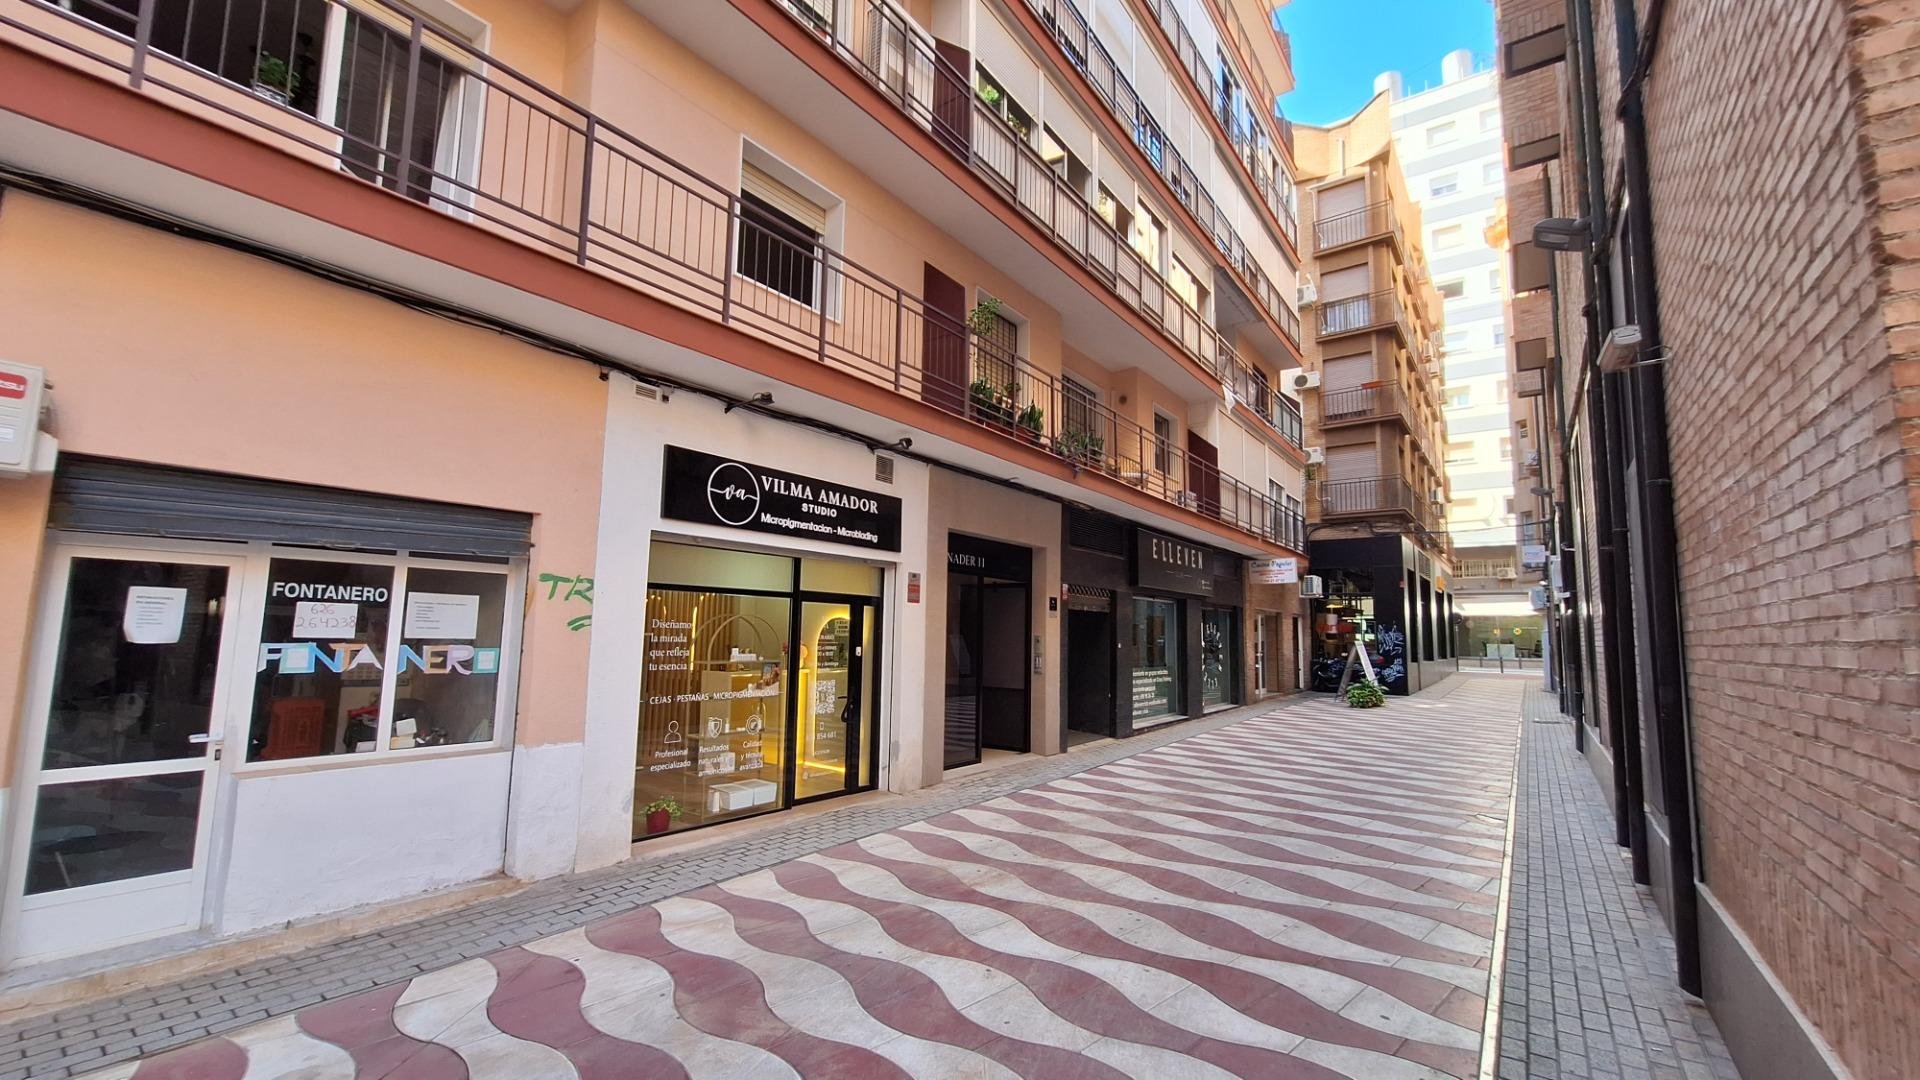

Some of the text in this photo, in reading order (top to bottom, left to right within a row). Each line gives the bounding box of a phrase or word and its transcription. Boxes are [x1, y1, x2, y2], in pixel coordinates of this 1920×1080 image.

[761, 475, 879, 514] VILMA AMADOR
[802, 503, 837, 518] STUDIO
[272, 582, 388, 602] FONTANERO
[311, 603, 335, 614] 626
[295, 615, 357, 628] 264238
[650, 632, 687, 642] la mirada
[649, 646, 689, 659] que refleja
[649, 662, 687, 671] tu esencia
[649, 695, 672, 705] CEJAS
[676, 692, 709, 703] PESTAÑAS
[655, 748, 688, 758] Profesional
[699, 744, 729, 753] Resultados
[650, 759, 692, 773] especializado
